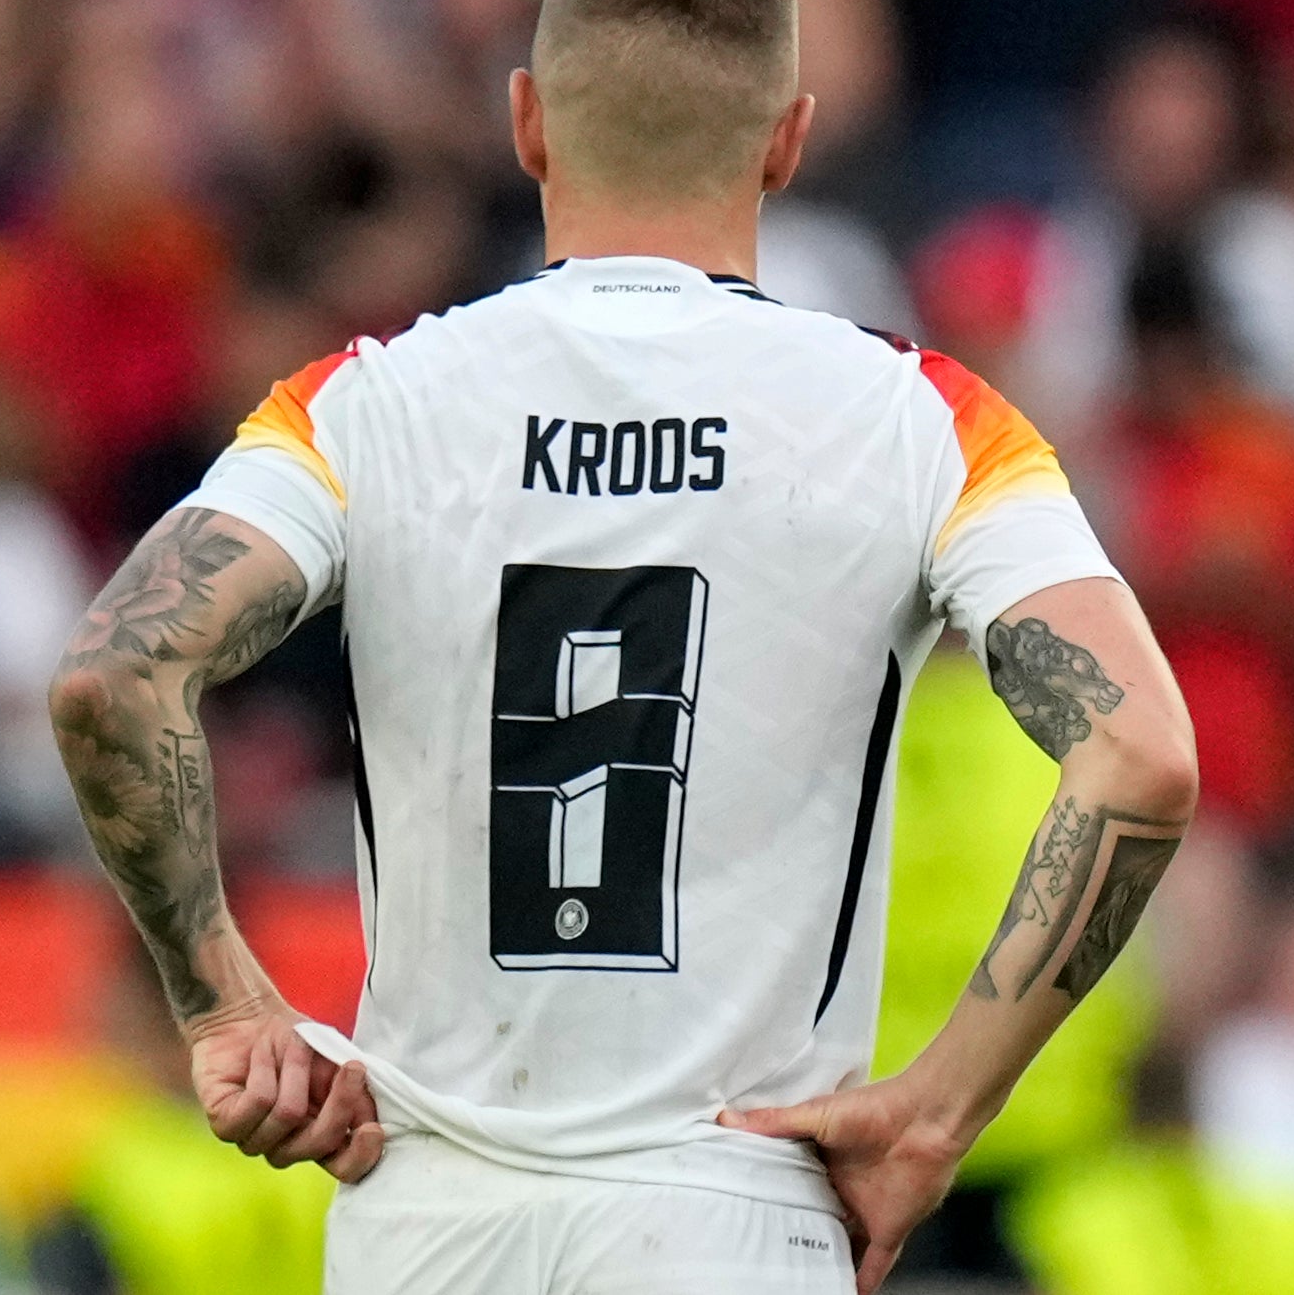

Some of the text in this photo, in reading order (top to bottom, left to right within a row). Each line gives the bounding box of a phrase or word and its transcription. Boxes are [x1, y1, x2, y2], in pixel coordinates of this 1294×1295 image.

[592, 283, 682, 294] DEUTSCHLAND
[521, 414, 728, 496] KROOS
[489, 563, 710, 973] 8
